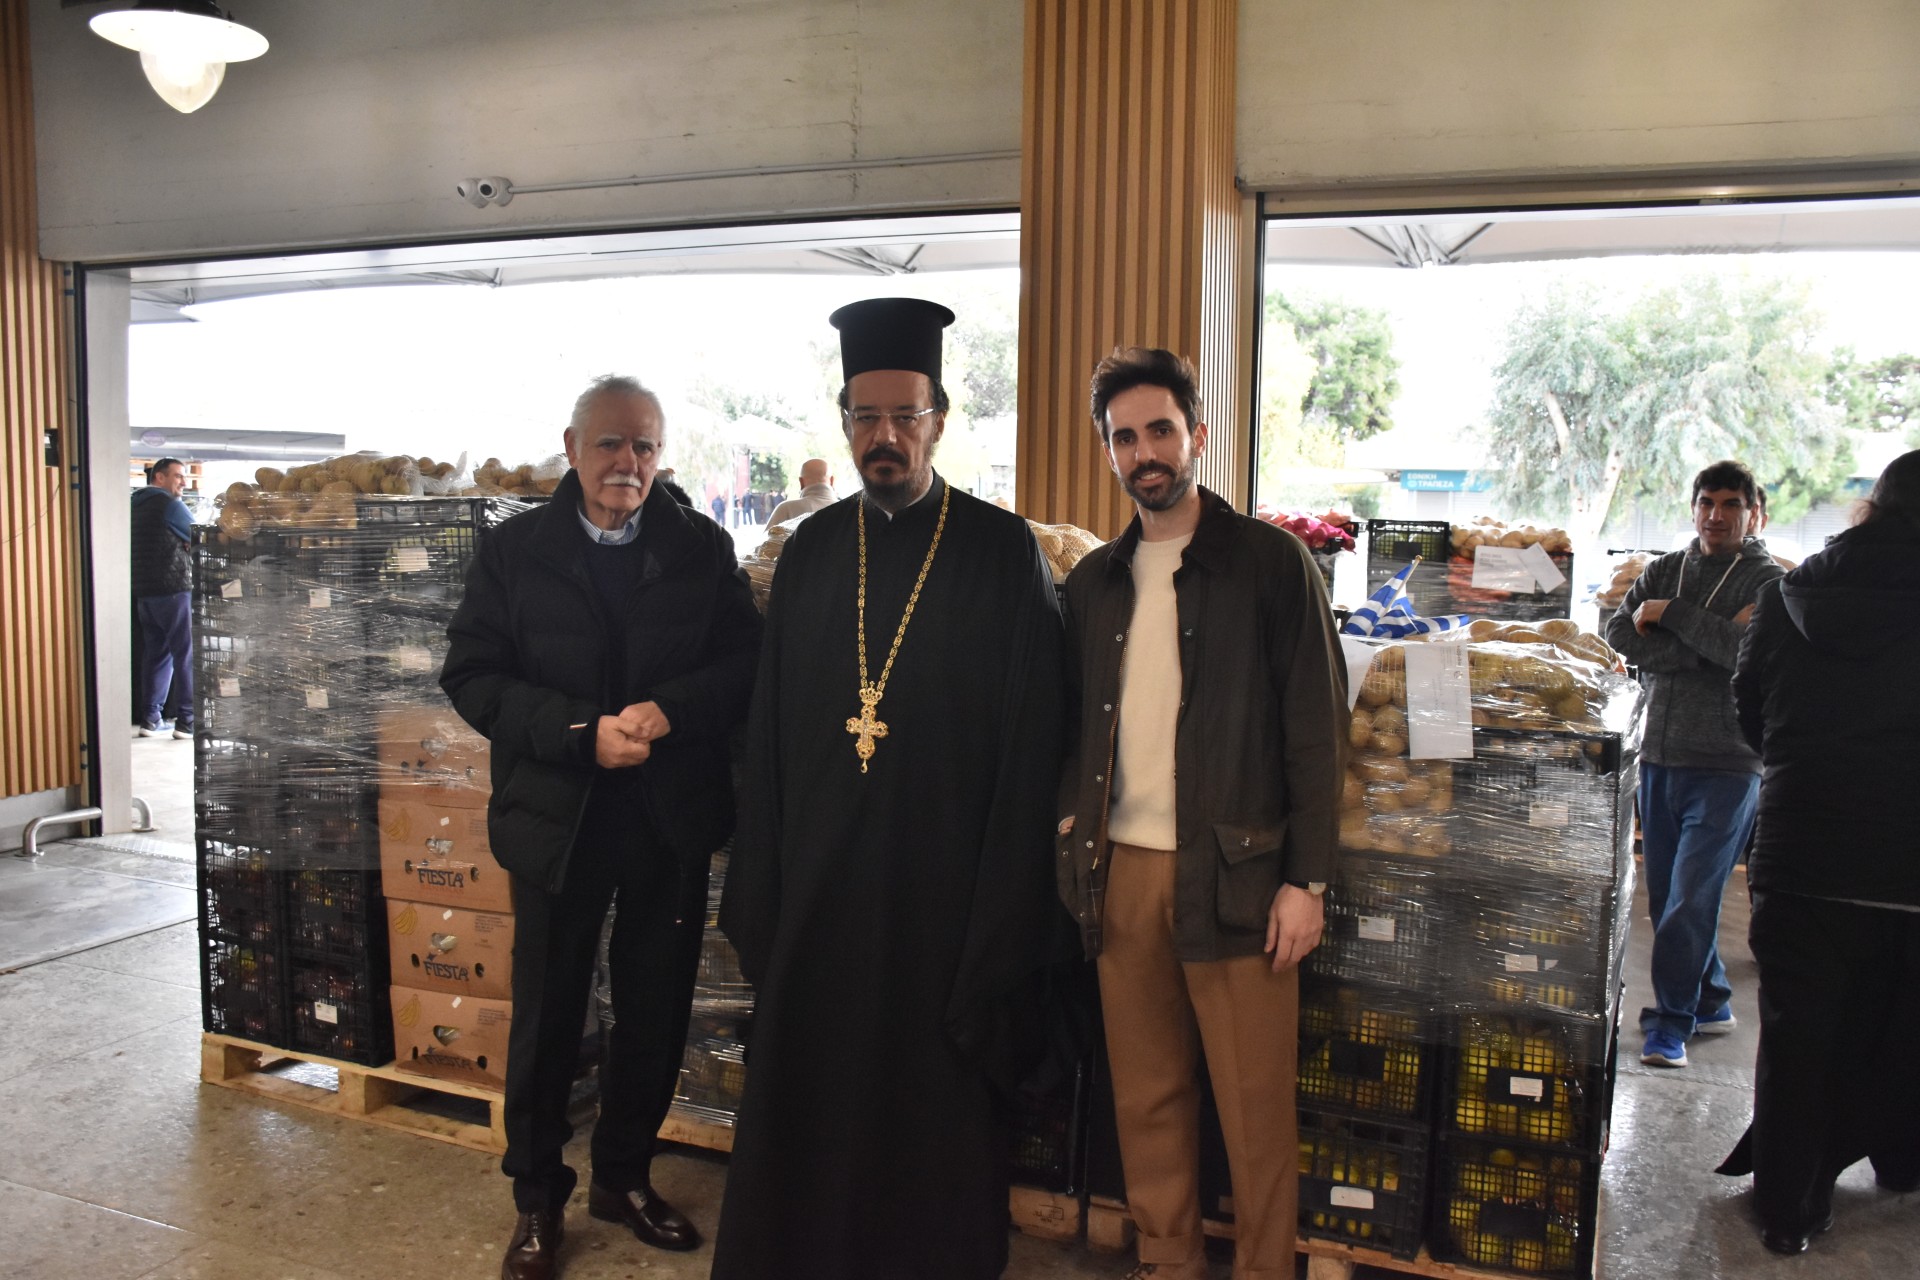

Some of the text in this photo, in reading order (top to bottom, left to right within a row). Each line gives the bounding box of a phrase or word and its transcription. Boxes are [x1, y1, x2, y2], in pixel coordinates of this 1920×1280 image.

[416, 868, 464, 888] FIESTA
[423, 961, 469, 982] FIESTA
[422, 1054, 473, 1071] FIESTA
